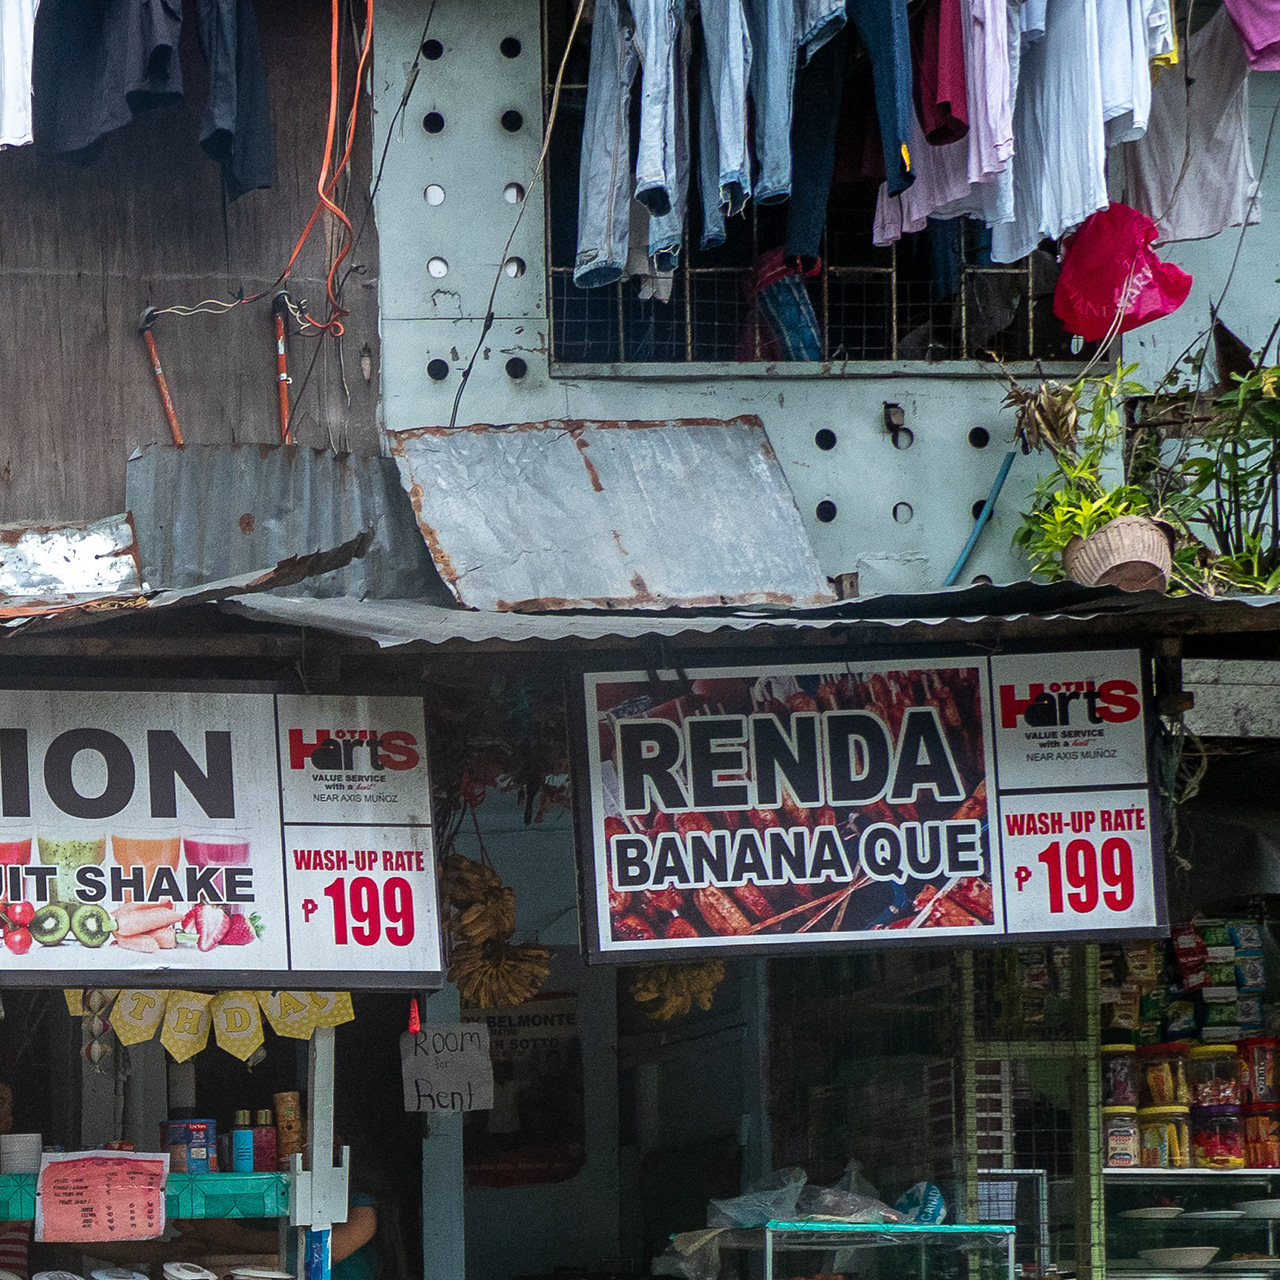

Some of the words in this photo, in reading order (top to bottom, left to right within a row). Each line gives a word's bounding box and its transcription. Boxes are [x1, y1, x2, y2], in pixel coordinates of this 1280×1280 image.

[1025, 731, 1058, 740] VALUE
[1059, 729, 1105, 739] SERVICE
[1038, 739, 1060, 748] with
[616, 708, 966, 816] RENDA
[1026, 752, 1054, 762] NEAR
[1055, 751, 1079, 761] AXIS
[1080, 748, 1118, 761] MUÑOZ
[311, 774, 343, 782] VALUE
[345, 774, 386, 783] SERVICE
[313, 794, 339, 803] NEAR
[340, 794, 362, 803] AXIS
[1005, 811, 1096, 836] WASH-UP
[1100, 808, 1146, 832] RATE
[294, 850, 378, 872] WASH-UP
[381, 850, 424, 872] RATE
[613, 827, 852, 890] BANANA
[861, 819, 984, 884] QUE
[75, 865, 256, 903] SHAKE
[1038, 837, 1136, 915] 199
[324, 876, 415, 947] 199
[486, 1013, 576, 1028] BELMONTE
[414, 1079, 475, 1111] Rent
